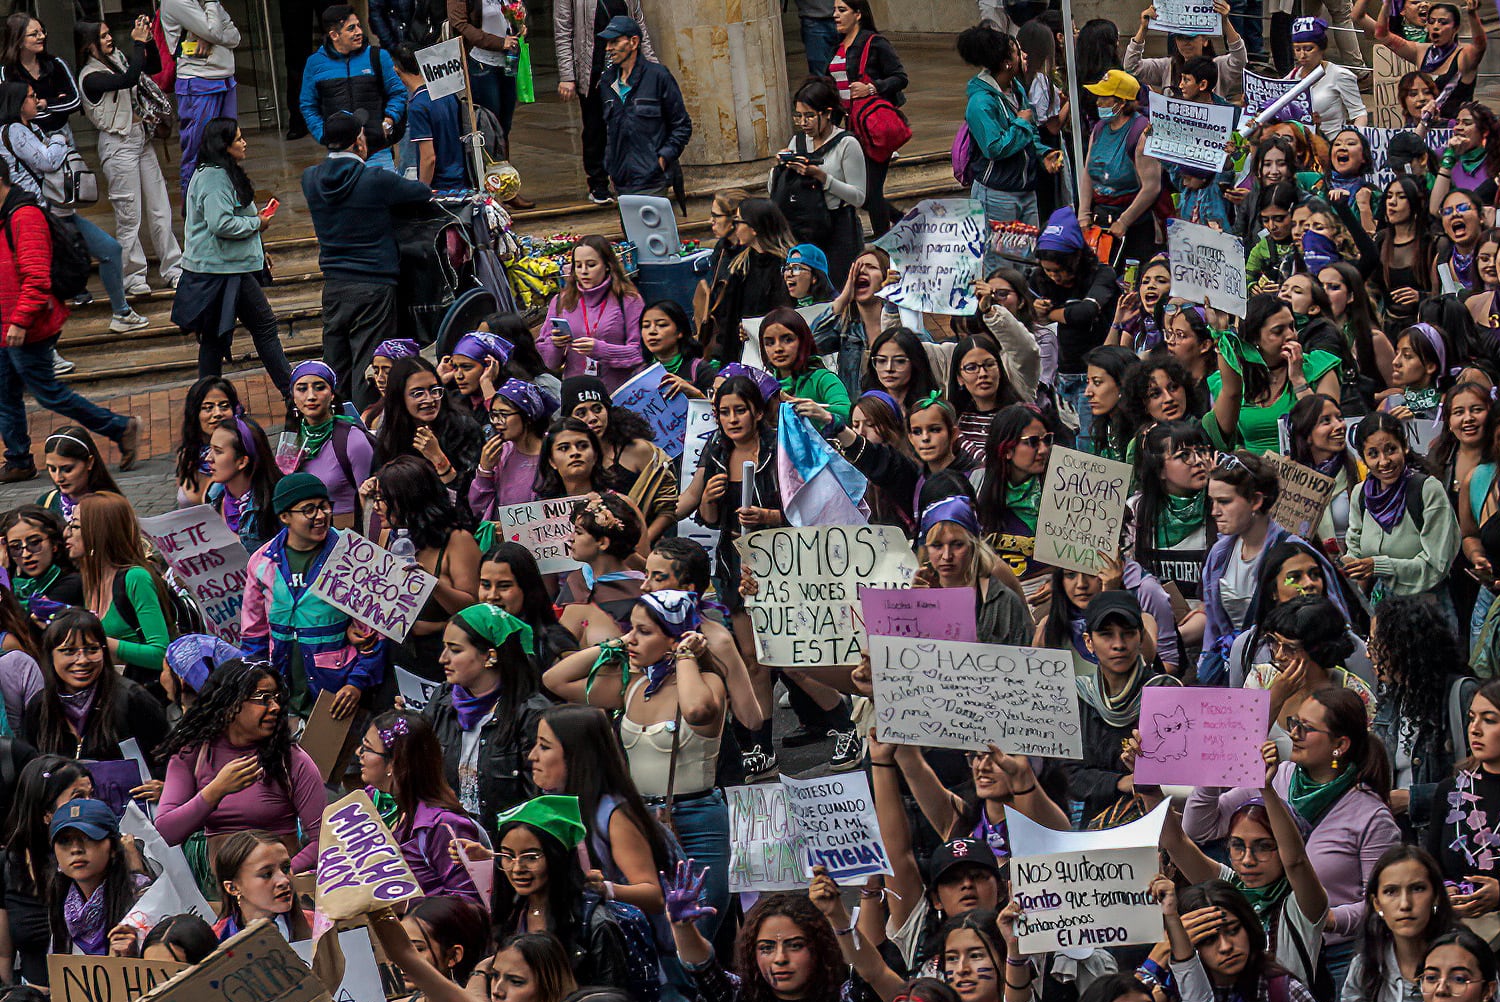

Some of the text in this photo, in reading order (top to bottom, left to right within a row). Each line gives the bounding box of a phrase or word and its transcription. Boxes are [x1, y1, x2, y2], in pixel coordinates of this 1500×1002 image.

[1053, 465, 1124, 506] SALVAR
[507, 505, 538, 527] SER
[1053, 493, 1108, 521] VIDAS
[1064, 513, 1093, 533] NO
[346, 533, 375, 563] YO
[747, 526, 877, 578] SOMOS
[799, 582, 846, 601] VOCES
[751, 605, 838, 636] QUE YA
[885, 645, 1068, 680] LO HAGO POR
[817, 798, 866, 815] CUANDO
[327, 802, 419, 901] MARCHO
[826, 830, 871, 846] CULPA
[318, 846, 362, 896] HOY
[1054, 854, 1134, 884] quitaron
[1014, 888, 1091, 911] Tanto que
[1078, 926, 1128, 946] MIEDO
